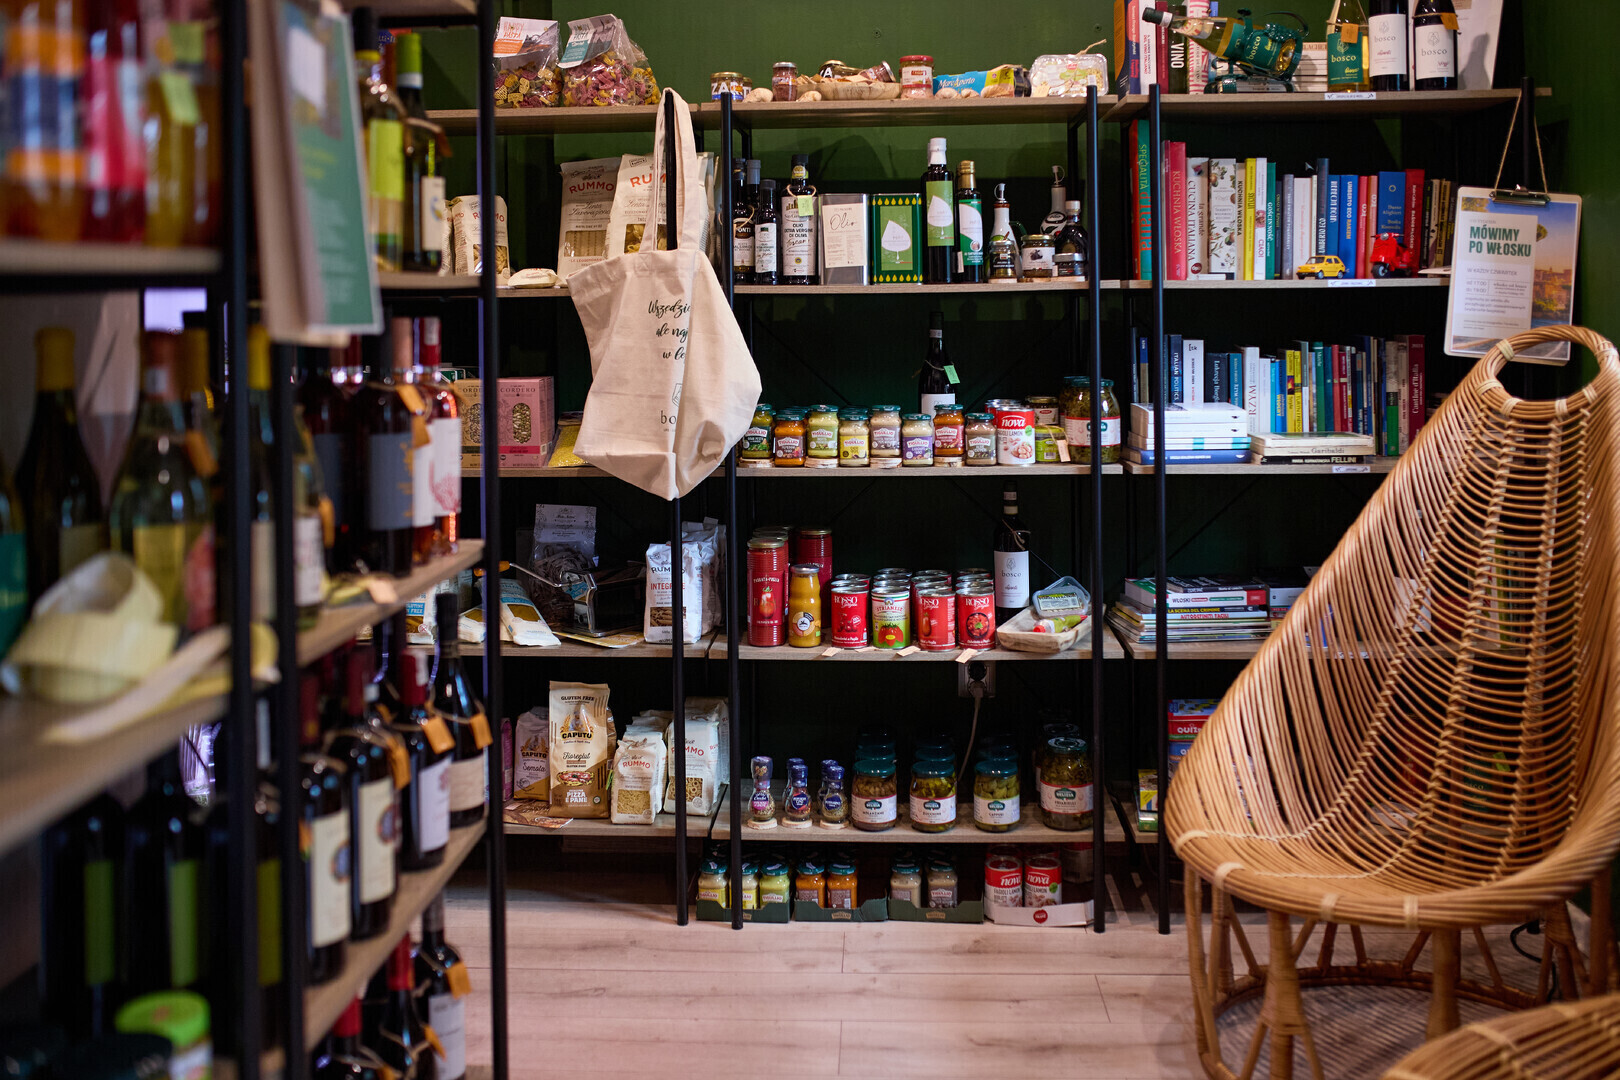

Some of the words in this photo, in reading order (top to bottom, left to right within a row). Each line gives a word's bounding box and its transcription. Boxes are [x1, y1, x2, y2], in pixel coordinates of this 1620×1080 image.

[1374, 35, 1396, 43] bosco
[1249, 36, 1261, 60] bosco
[1421, 47, 1448, 57] bosco
[1170, 43, 1185, 69] VINO
[1331, 54, 1357, 63] bosco
[569, 181, 614, 194] RUMMO
[1172, 171, 1181, 214] KUCHNIA
[1187, 180, 1196, 216] CUCINA
[1197, 211, 1206, 236] grande
[1172, 216, 1182, 254] WŁOSKA
[1187, 219, 1196, 261] ITALIANA
[1470, 224, 1520, 241] MÓWIMY
[1469, 240, 1483, 253] PO
[1487, 241, 1532, 257] WŁOSKU
[655, 322, 670, 337] ale
[662, 351, 672, 359] w
[1249, 384, 1257, 415] RZYM
[1001, 418, 1026, 427] nova
[834, 596, 858, 604] ROSSO
[965, 598, 990, 606] ROSSO
[622, 760, 651, 768] RUMMO
[1027, 875, 1050, 885] nova
